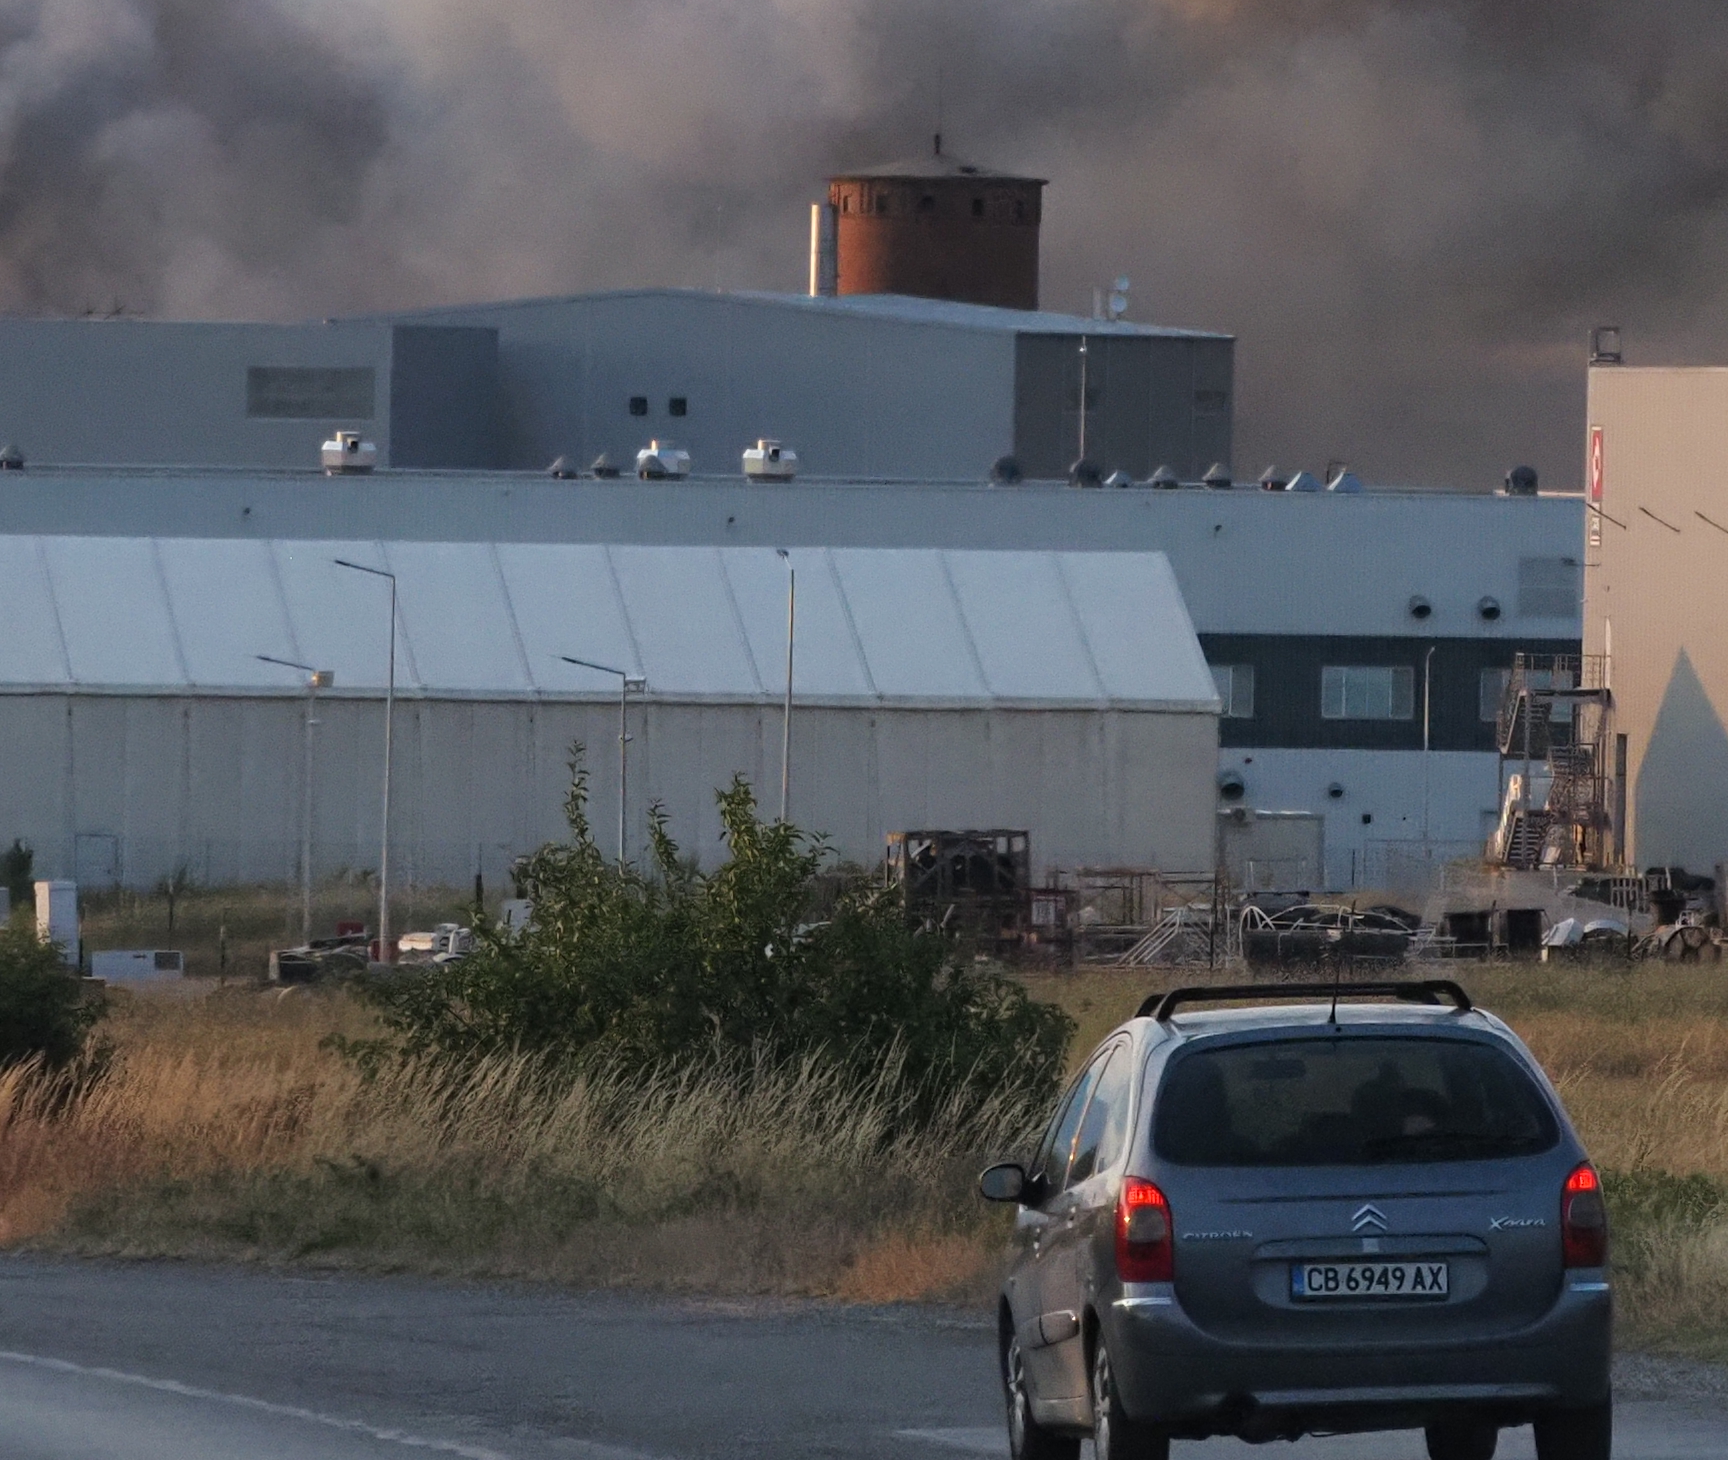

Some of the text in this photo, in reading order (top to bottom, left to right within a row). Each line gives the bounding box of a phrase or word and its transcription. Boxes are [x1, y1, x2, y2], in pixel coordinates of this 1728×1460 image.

[1308, 1266, 1443, 1292] CB 6949 AX
